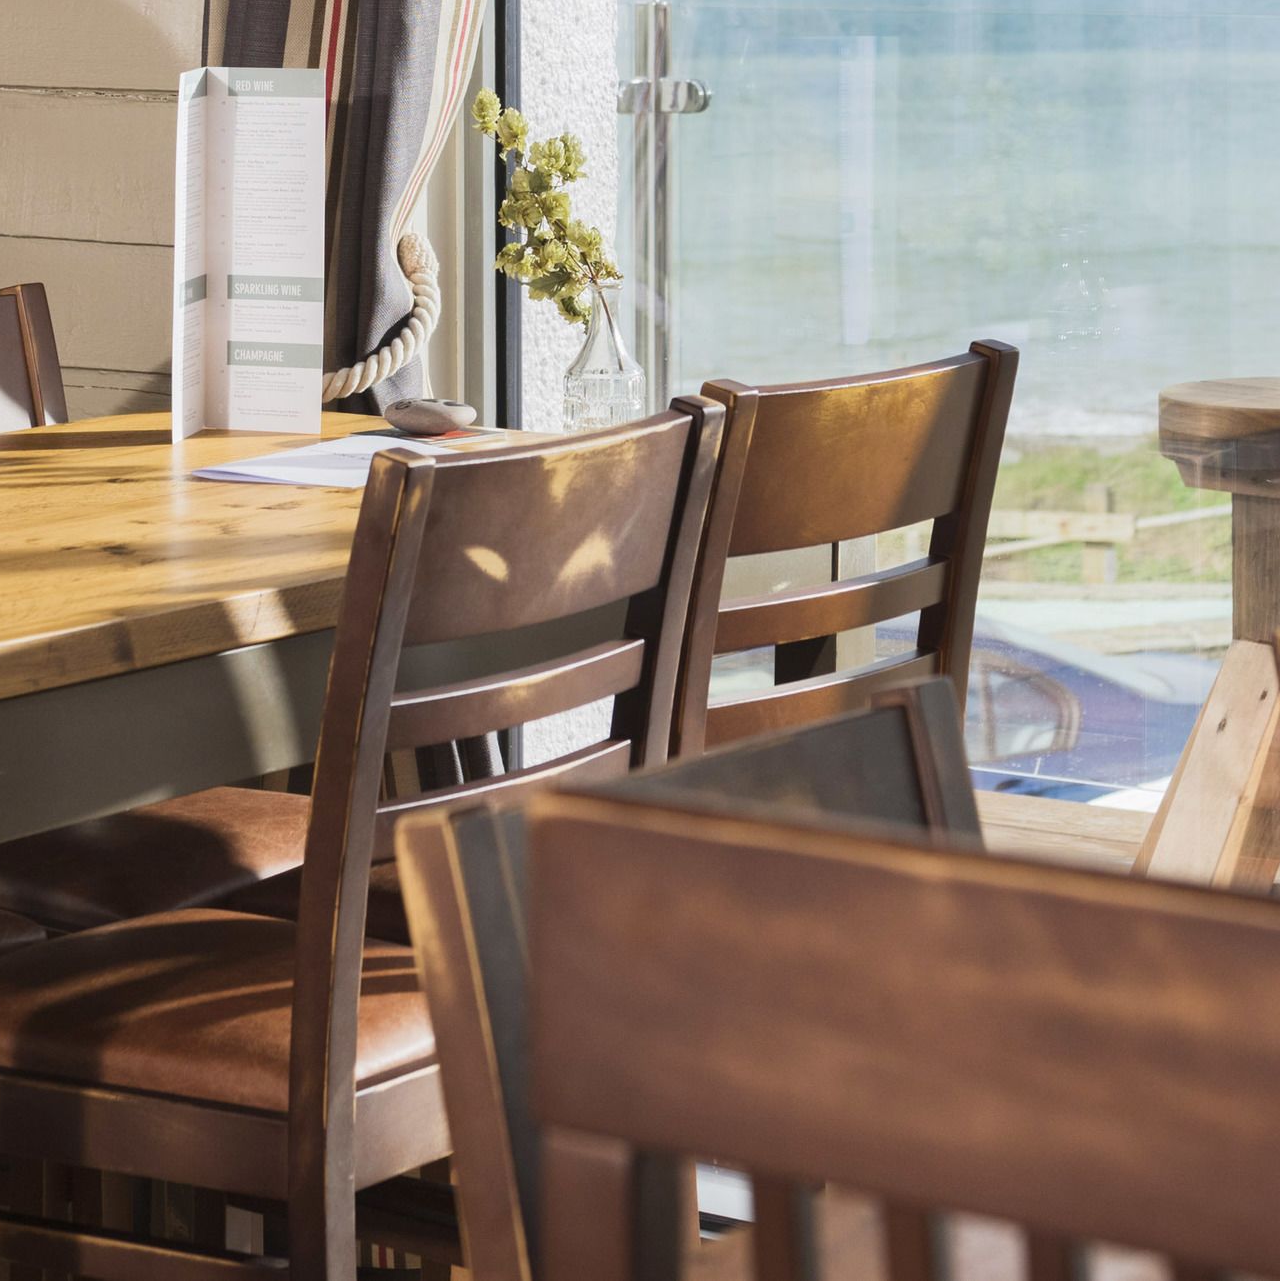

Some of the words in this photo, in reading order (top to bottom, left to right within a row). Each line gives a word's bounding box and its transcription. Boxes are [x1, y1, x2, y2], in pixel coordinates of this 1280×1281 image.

[235, 79, 251, 92] RED
[254, 79, 275, 92] WINE
[233, 282, 279, 296] SPARKLING
[280, 284, 302, 297] WINE
[233, 348, 285, 362] CHAMPAGNE
